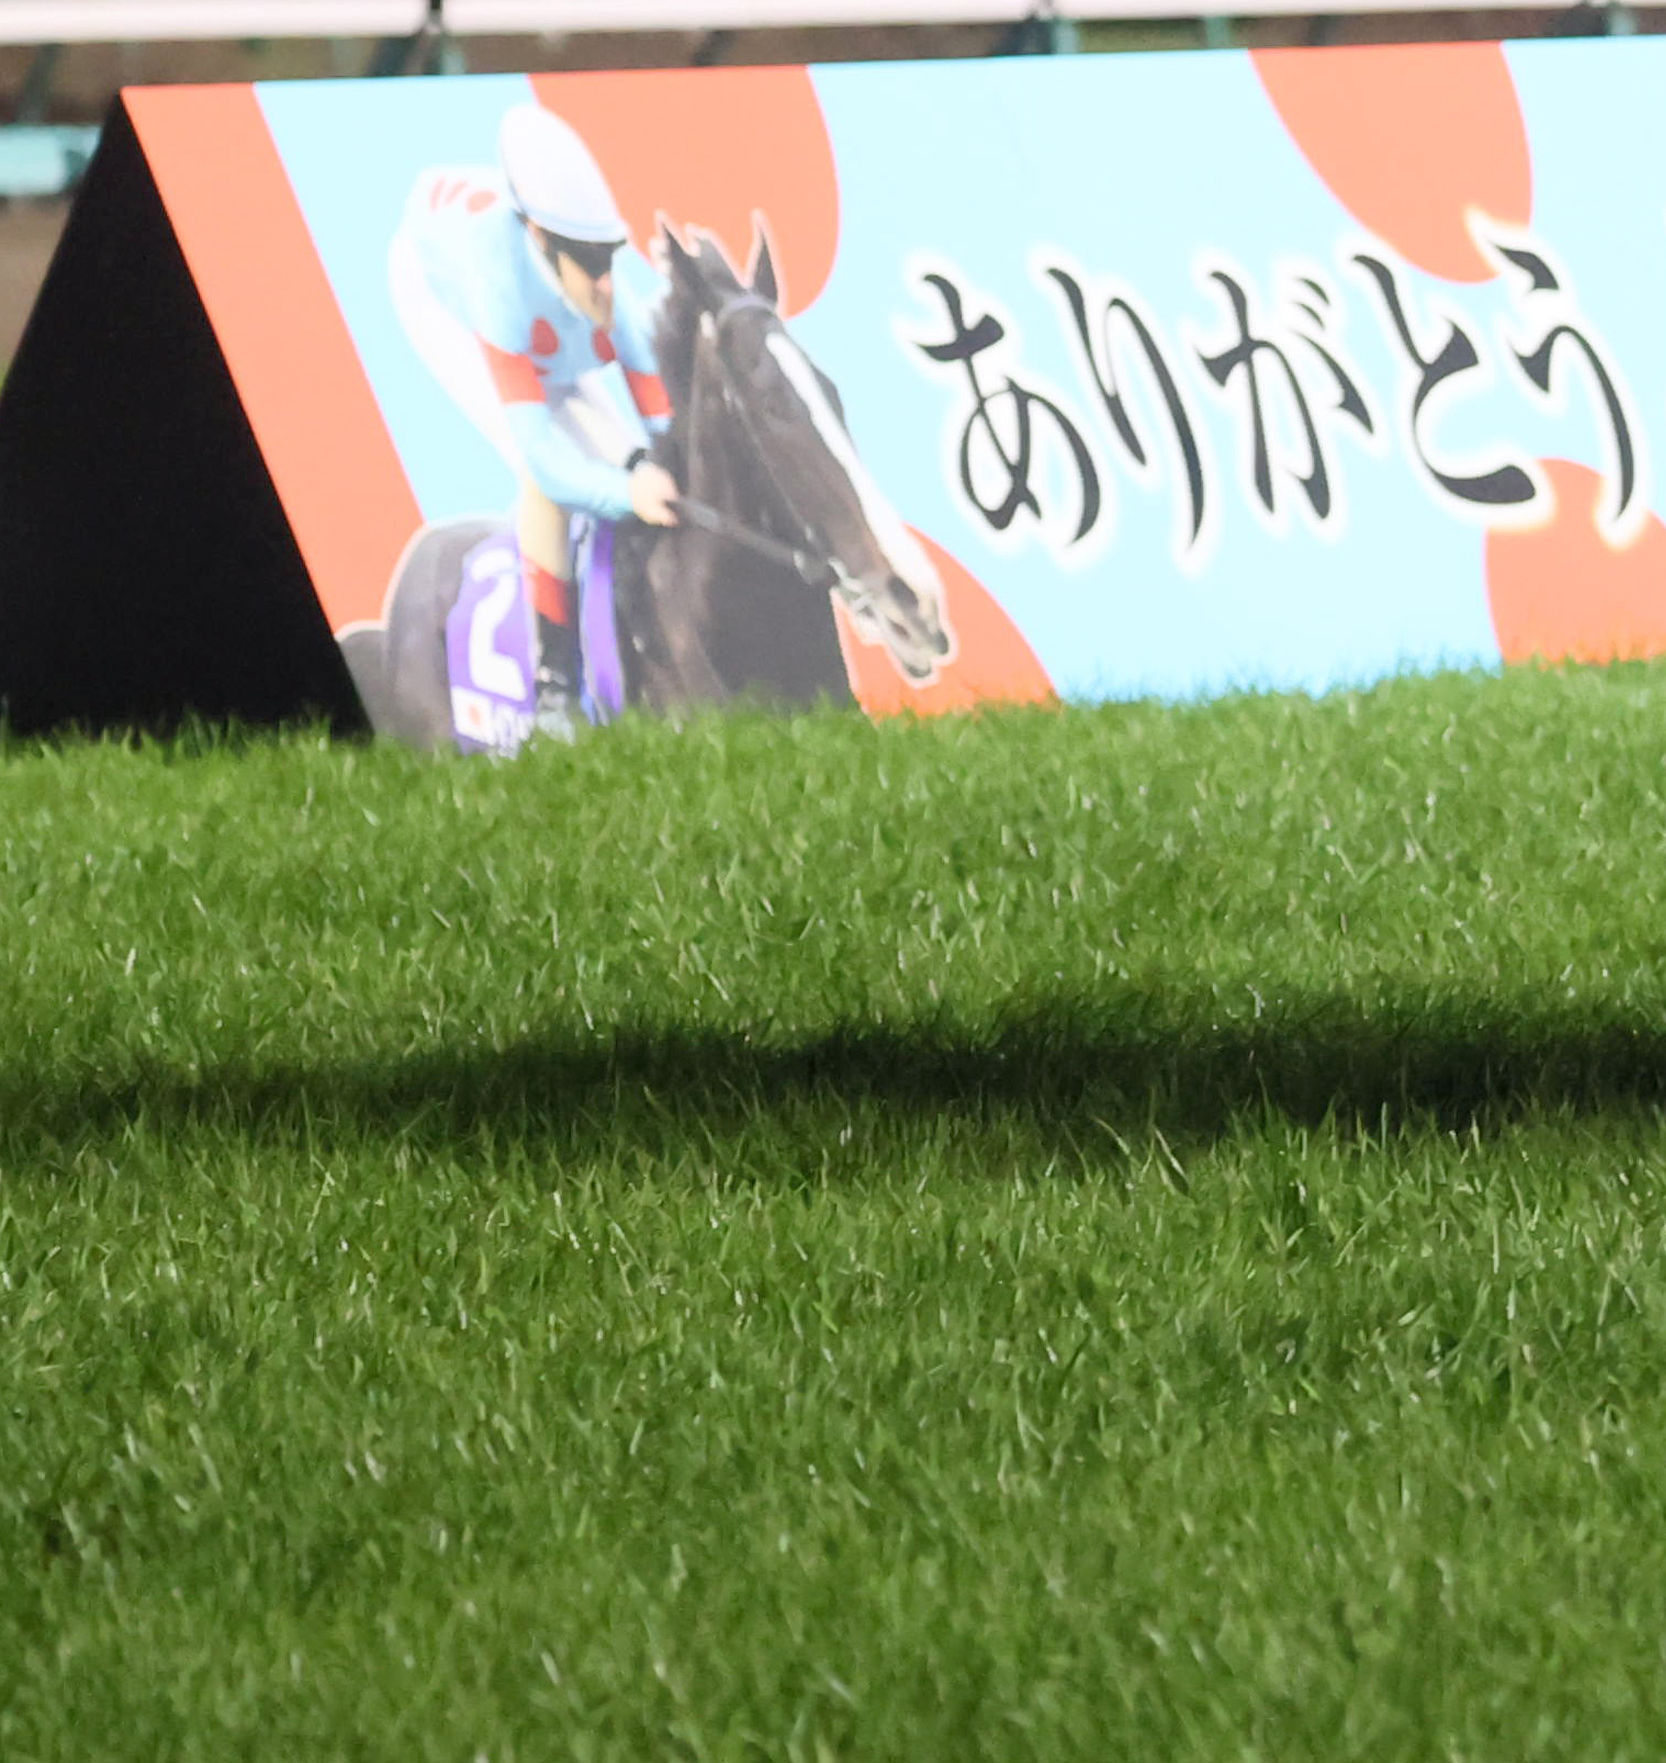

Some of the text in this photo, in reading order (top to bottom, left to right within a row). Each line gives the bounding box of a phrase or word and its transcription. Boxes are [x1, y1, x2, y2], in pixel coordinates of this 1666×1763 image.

[914, 242, 1635, 547] ありがとう
[468, 547, 528, 703] 2
